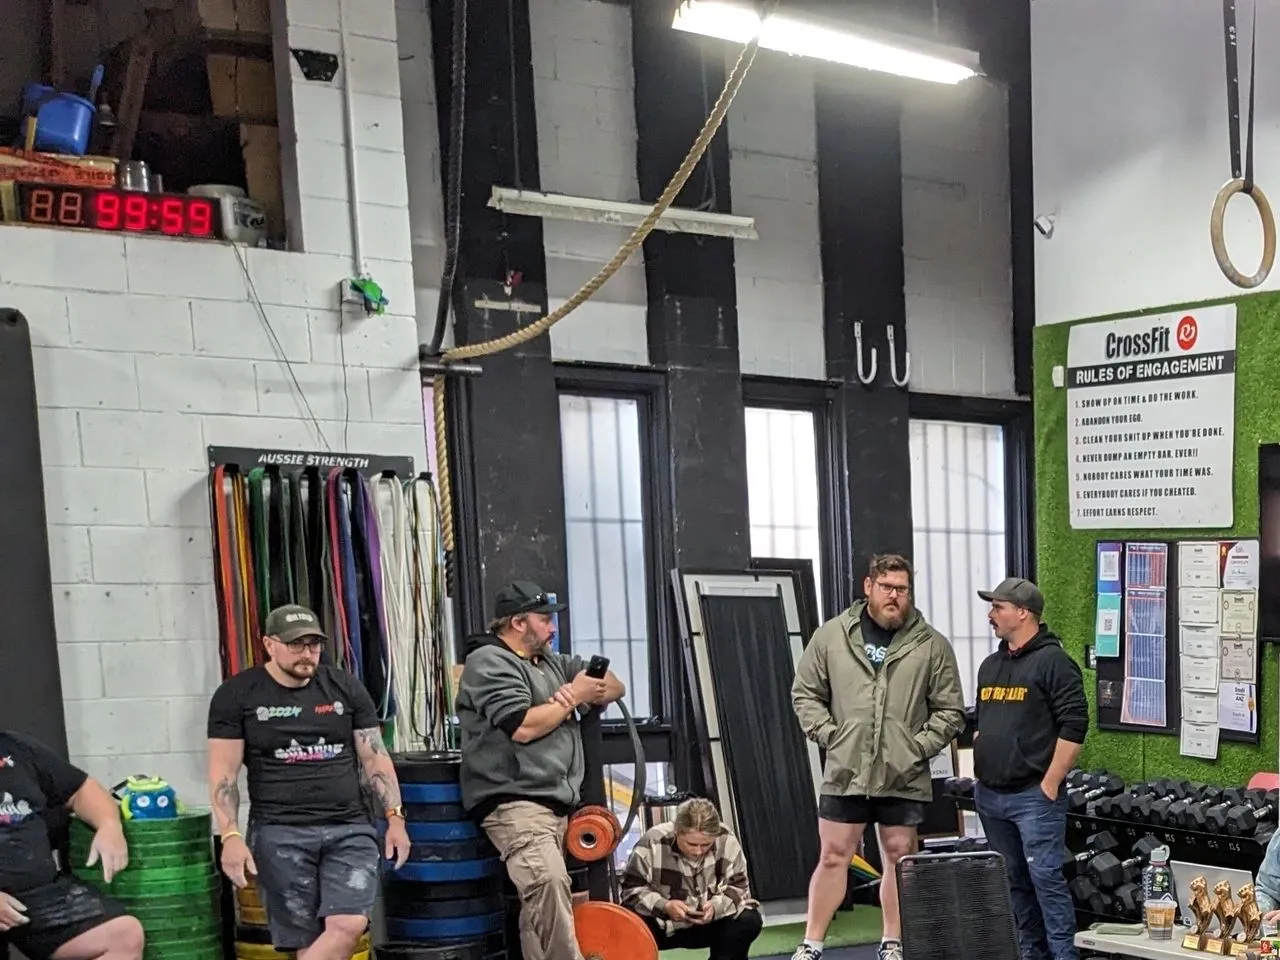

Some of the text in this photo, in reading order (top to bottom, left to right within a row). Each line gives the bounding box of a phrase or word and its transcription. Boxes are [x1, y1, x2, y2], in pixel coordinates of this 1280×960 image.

[95, 194, 213, 236] 99:59
[1106, 326, 1170, 359] CrossFit
[1076, 355, 1225, 385] RULES OF ENGAGEMENT
[1082, 398, 1101, 408] SHOW
[1103, 397, 1112, 407] UP
[1113, 396, 1122, 406] ON
[1124, 395, 1141, 405] TIME
[1148, 393, 1158, 403] DO
[1160, 392, 1173, 402] THE
[1174, 390, 1199, 401] WORK.
[1082, 415, 1110, 426] ABANDON
[1112, 414, 1128, 424] YOUR
[1129, 413, 1143, 423] EGO.
[1083, 434, 1102, 445] CLEAN
[1104, 433, 1122, 443] YOUR
[1124, 432, 1140, 442] SHIT
[1142, 431, 1151, 441] UP
[1153, 430, 1174, 440] WHEN
[1175, 428, 1201, 439] YOU'RE
[1203, 427, 1225, 437] DONE.
[258, 453, 369, 468] AUSSIE STRENGTH
[1082, 453, 1102, 463] NEVER
[1104, 452, 1122, 462] DUMP
[1124, 451, 1132, 461] AN
[1134, 450, 1156, 460] EMPTY
[1175, 448, 1198, 458] EVER!!
[1083, 471, 1109, 481] NOBODY
[1110, 470, 1132, 480] CARES
[1133, 469, 1154, 479] WHAT
[1155, 468, 1174, 478] YOUR
[1175, 468, 1193, 477] TIME
[1194, 466, 1214, 476] WAS.
[1083, 488, 1118, 499] EVERYBODY
[1119, 488, 1141, 498] CARES
[1142, 487, 1148, 497] IF
[1149, 487, 1162, 497] YOU
[1164, 486, 1197, 496] CHEATED.
[1083, 507, 1104, 517] EFFORT
[1105, 507, 1126, 517] EARNS
[1127, 506, 1158, 516] RESPECT.
